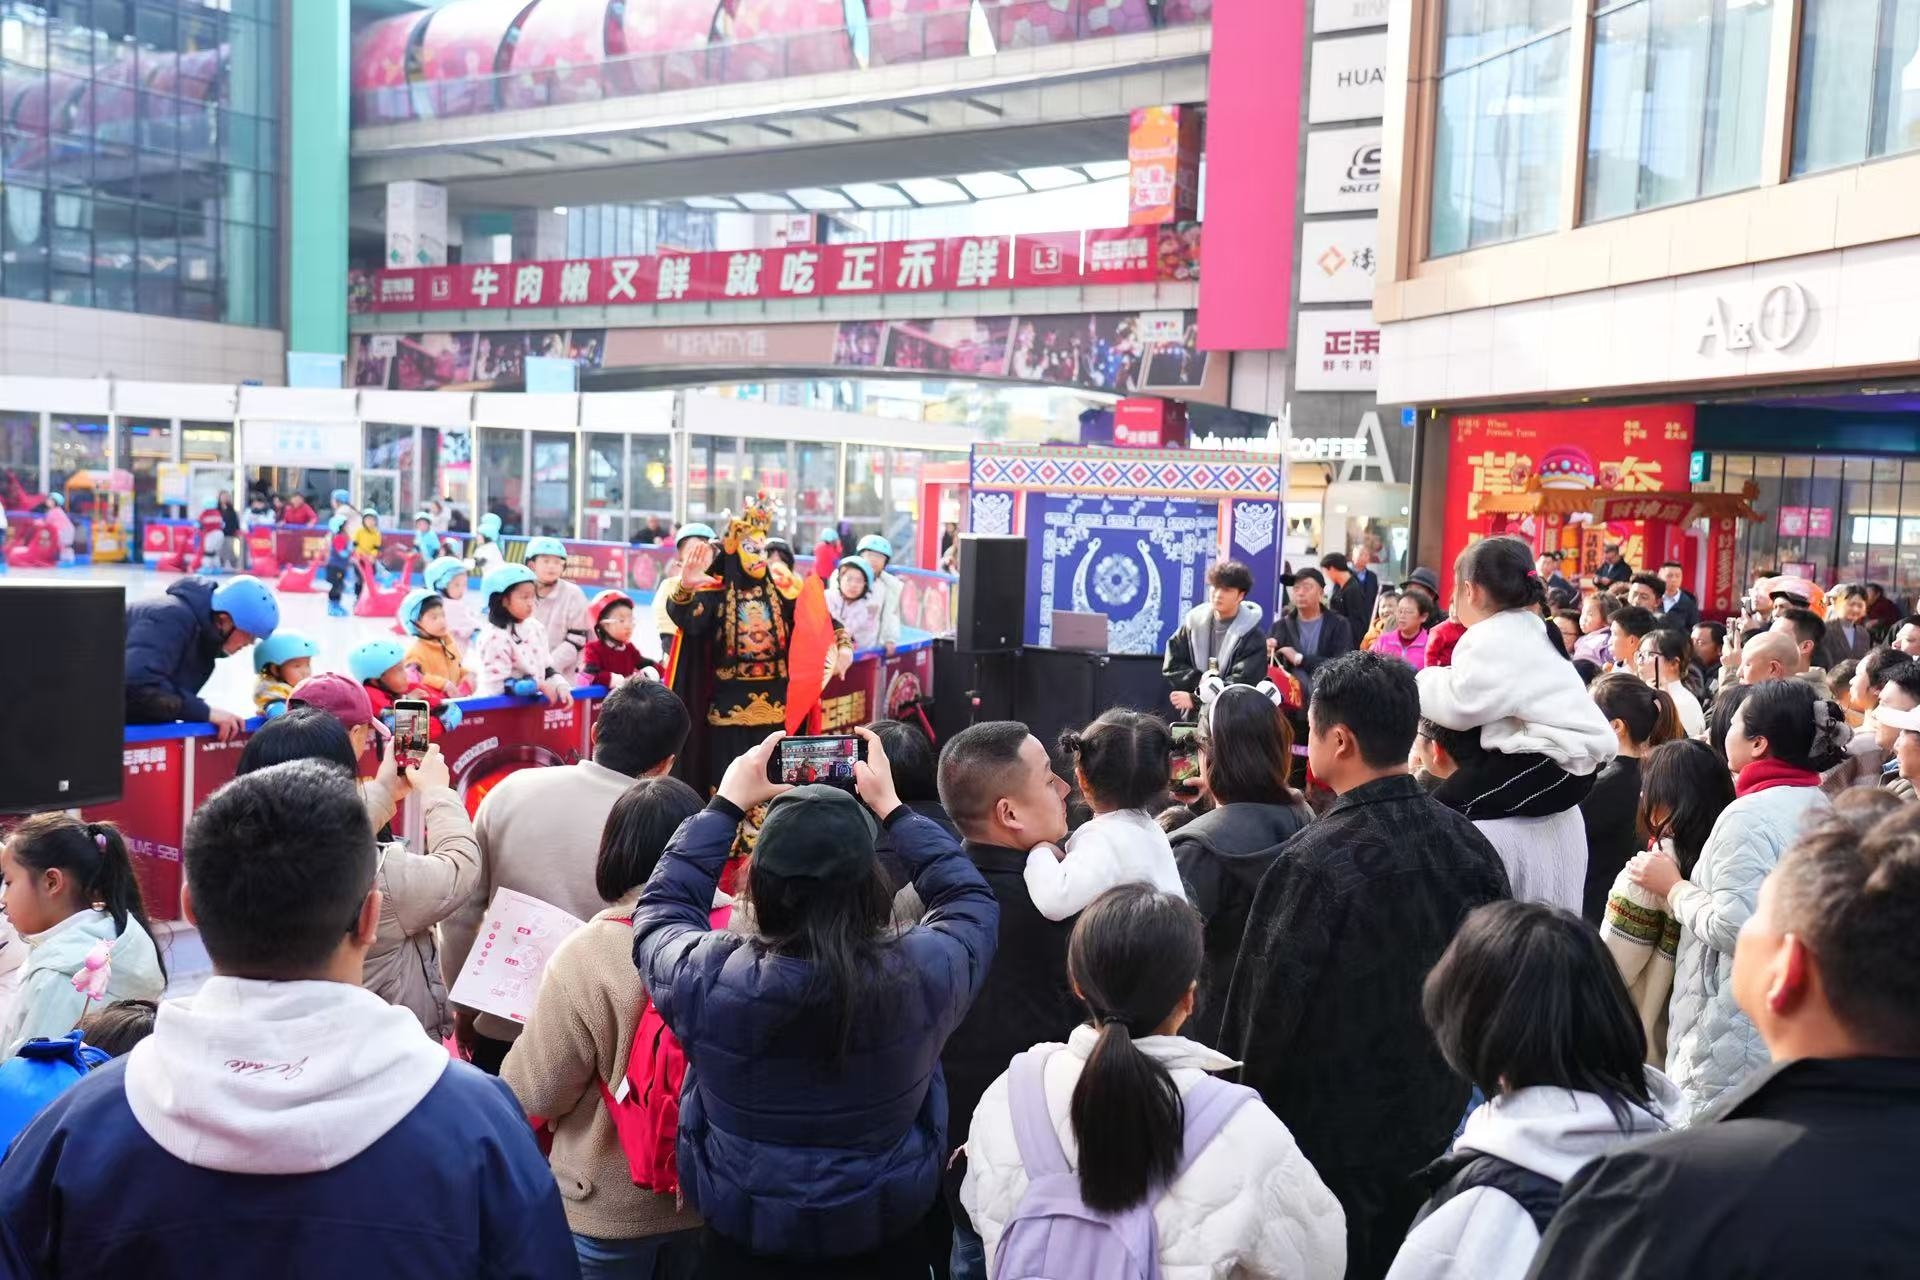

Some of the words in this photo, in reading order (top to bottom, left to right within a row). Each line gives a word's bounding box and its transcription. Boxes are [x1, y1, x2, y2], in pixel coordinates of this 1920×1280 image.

[1337, 68, 1386, 87] HUA
[1034, 247, 1058, 269] L3
[471, 256, 691, 306] 牛肉嫩又鲜
[724, 239, 999, 296] 就吃正禾鲜
[433, 281, 449, 297] L3
